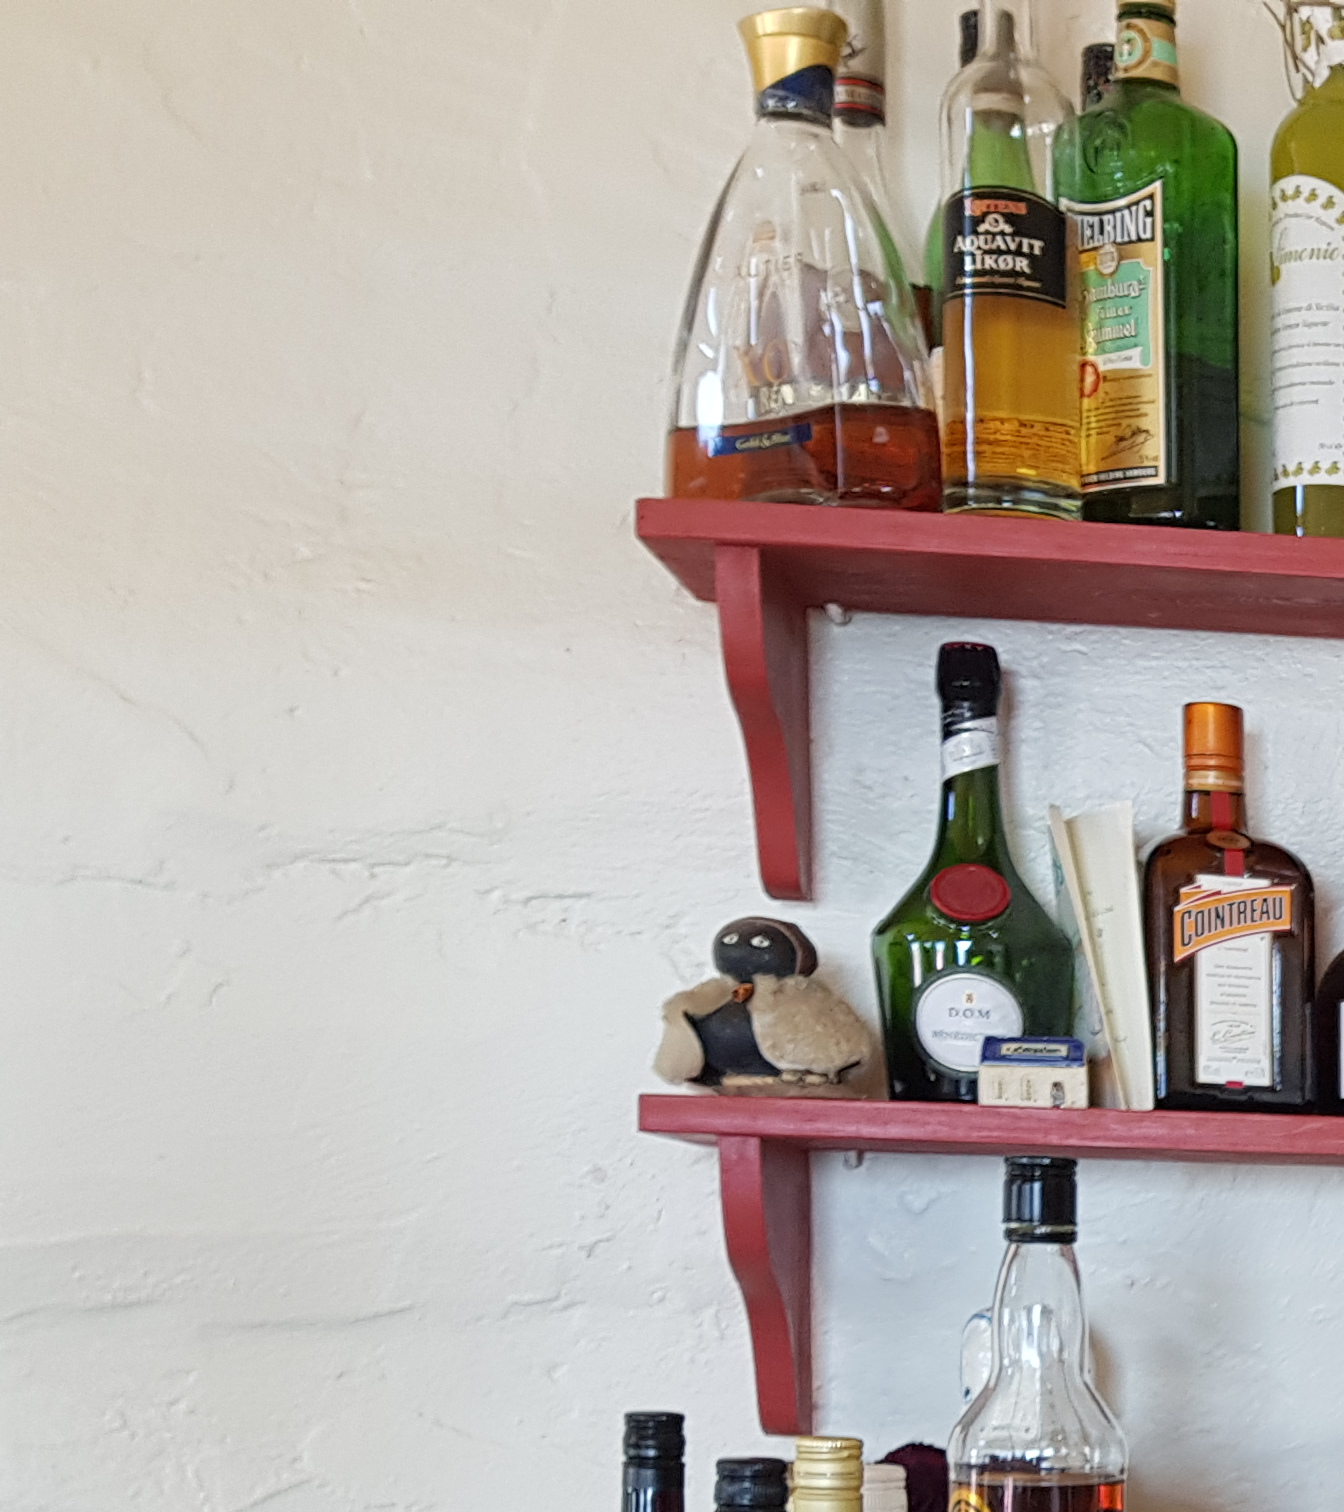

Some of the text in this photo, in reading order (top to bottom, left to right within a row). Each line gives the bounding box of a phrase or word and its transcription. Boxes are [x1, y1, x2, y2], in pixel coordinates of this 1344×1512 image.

[953, 233, 1045, 255] AQUAVIT
[964, 250, 1032, 275] LIKØR
[1180, 896, 1284, 948] COINTREAU
